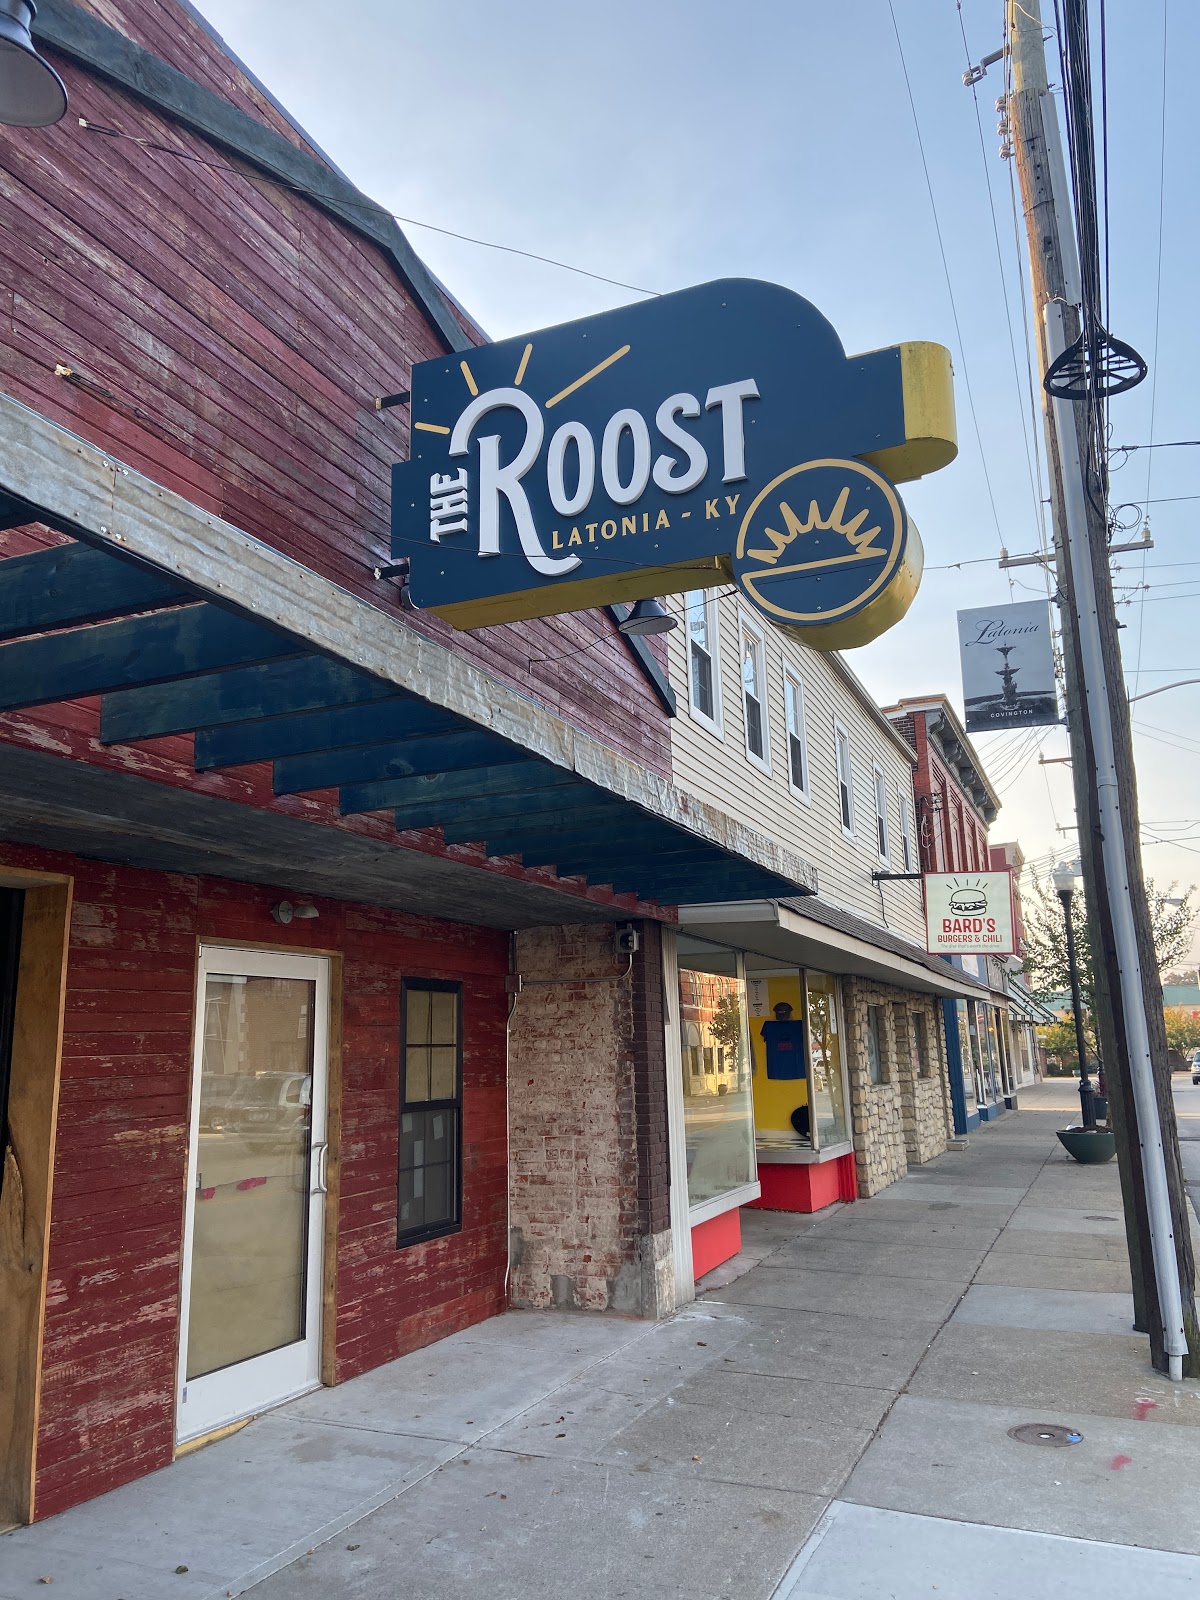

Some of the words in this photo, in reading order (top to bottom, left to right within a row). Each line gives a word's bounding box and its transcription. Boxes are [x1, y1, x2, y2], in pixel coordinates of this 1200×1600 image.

[430, 468, 469, 543] THE
[552, 509, 670, 549] LATONIA
[705, 494, 740, 519] KY
[965, 620, 1039, 646] Latonia
[990, 709, 1033, 718] COVINGTON
[942, 918, 996, 933] BARD'S
[937, 934, 973, 943] BURGERS
[974, 934, 981, 943] &
[982, 934, 1003, 943] CHILI
